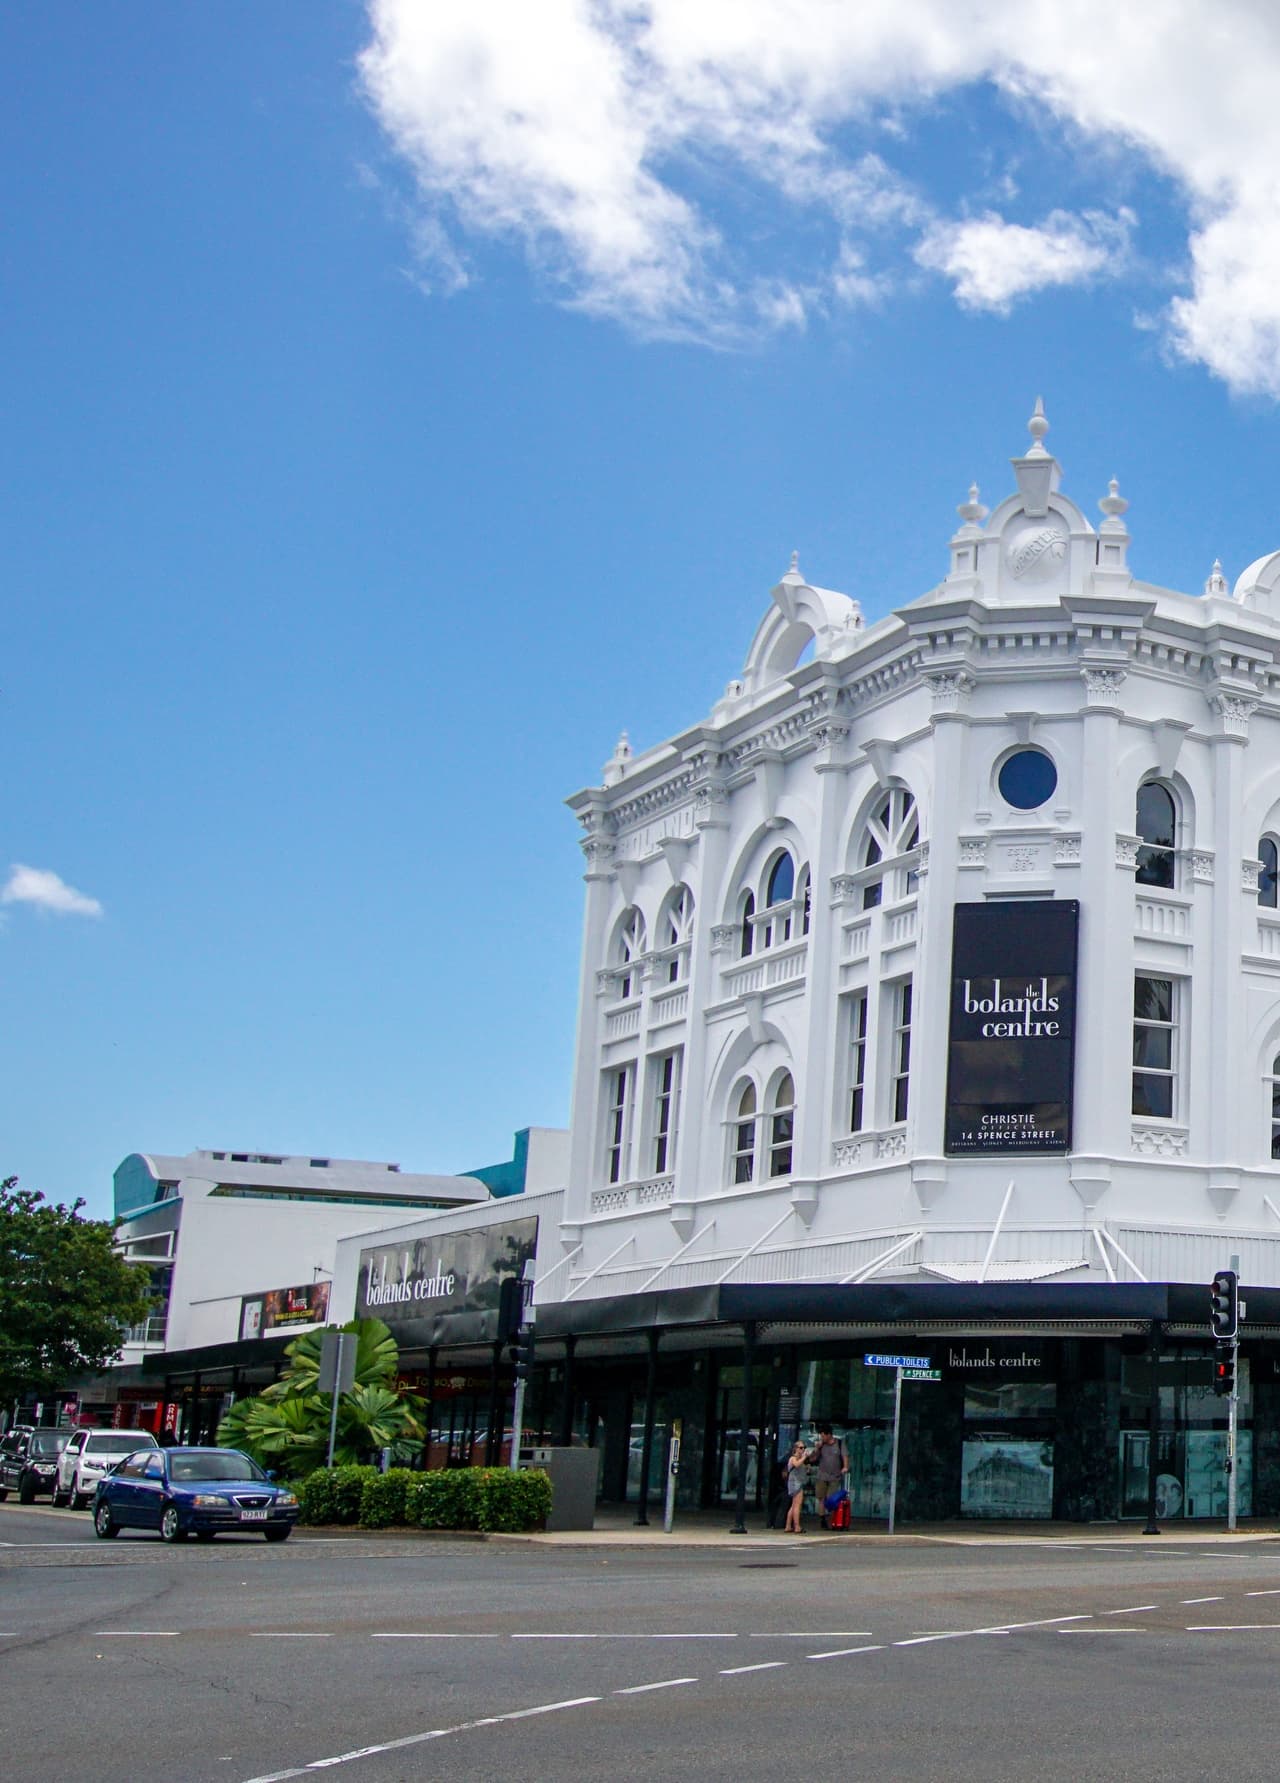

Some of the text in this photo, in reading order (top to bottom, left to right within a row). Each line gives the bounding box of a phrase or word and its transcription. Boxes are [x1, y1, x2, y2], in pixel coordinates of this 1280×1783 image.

[963, 978, 1060, 1014] bolands
[1026, 984, 1040, 998] the
[982, 1018, 1060, 1037] centre
[981, 1114, 1036, 1124] CHRISTIE
[962, 1130, 1056, 1140] 14 SPENCE STREET
[366, 1252, 455, 1306] bolands centre
[875, 1356, 929, 1367] PUBLIC TOILETS
[950, 1348, 1041, 1367] bolands centre
[912, 1369, 934, 1378] SPENCE
